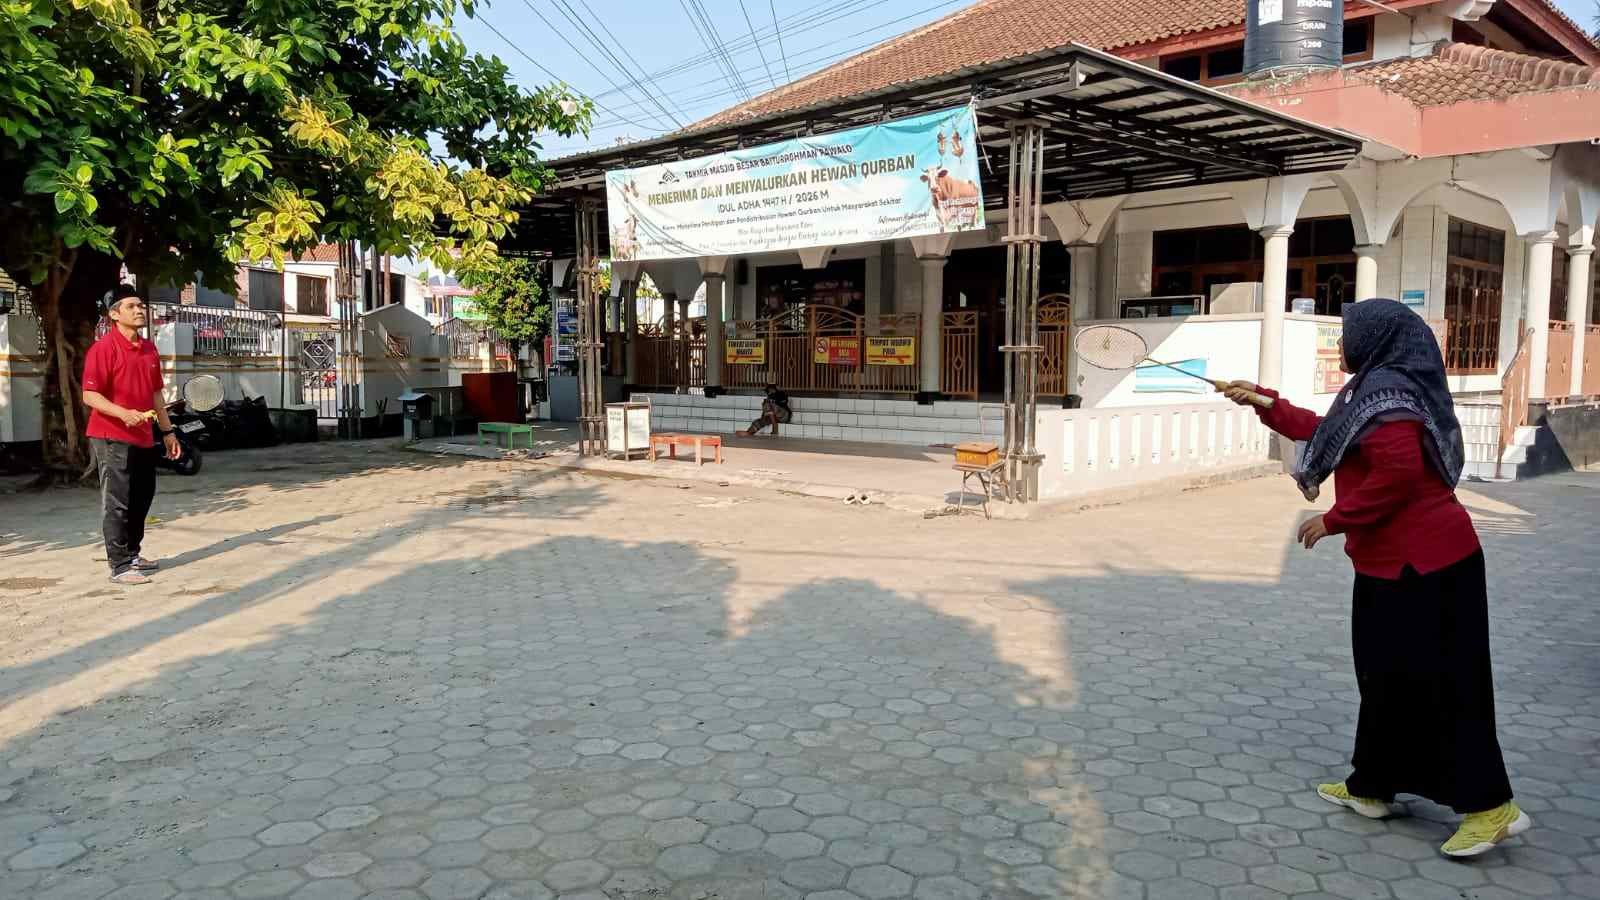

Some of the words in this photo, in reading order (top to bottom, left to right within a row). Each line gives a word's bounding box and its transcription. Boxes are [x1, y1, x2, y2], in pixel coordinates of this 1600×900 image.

[648, 188, 698, 206] MENERIMA
[701, 184, 722, 199] DAN
[725, 171, 807, 196] MENYALURKAN
[811, 163, 857, 184] HEWAN
[861, 154, 915, 179] QURBAN
[709, 164, 735, 176] MASJID
[736, 160, 760, 172] BESAR
[718, 203, 736, 214] IDUL
[738, 199, 761, 211] ADHA
[796, 191, 817, 203] 2026
[820, 189, 829, 199] M
